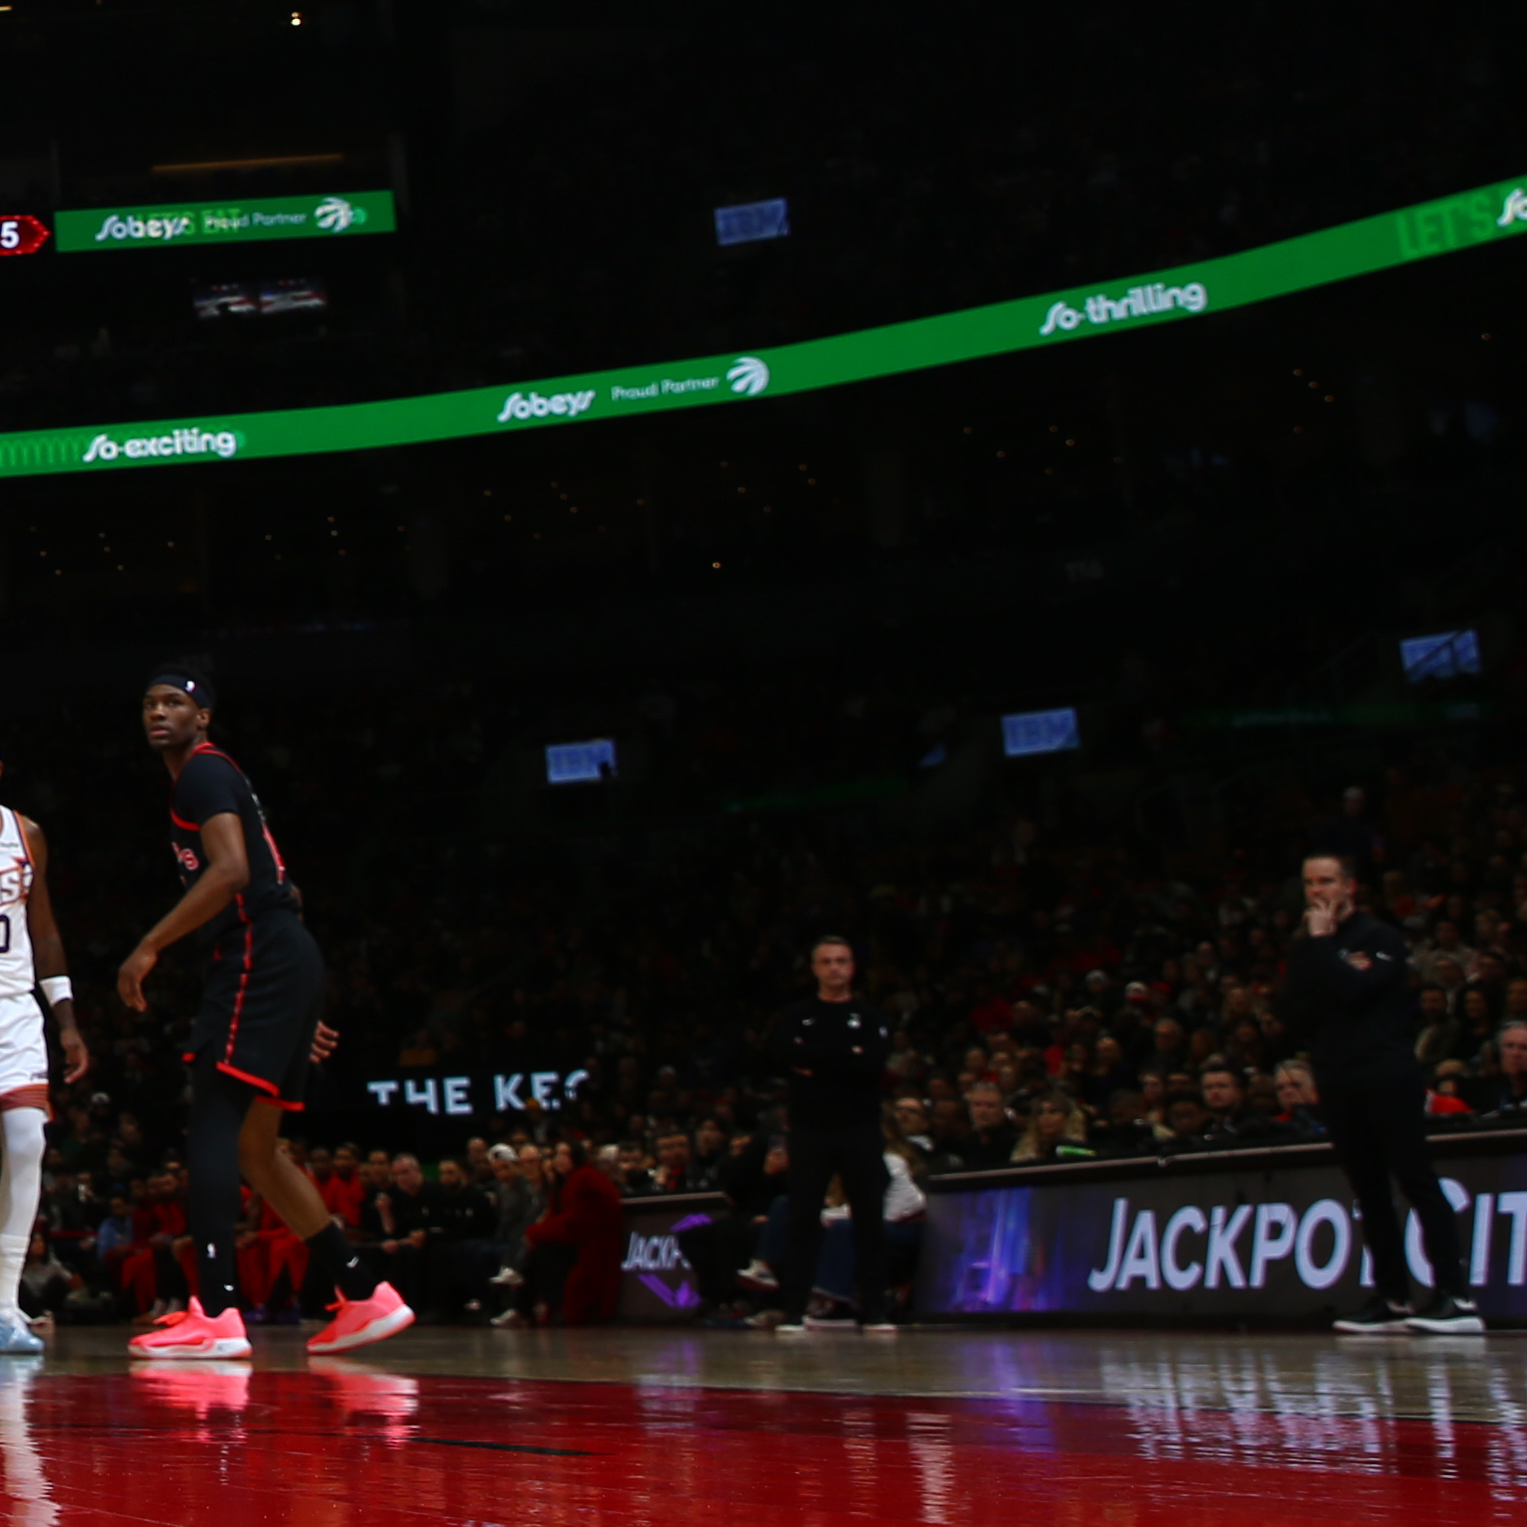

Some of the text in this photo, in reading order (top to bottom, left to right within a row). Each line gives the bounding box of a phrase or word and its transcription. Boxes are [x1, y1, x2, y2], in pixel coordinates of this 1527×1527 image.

[95, 213, 189, 242] Sobeys
[496, 374, 720, 424] Sobeys Proud Partner
[365, 1075, 475, 1117] THE
